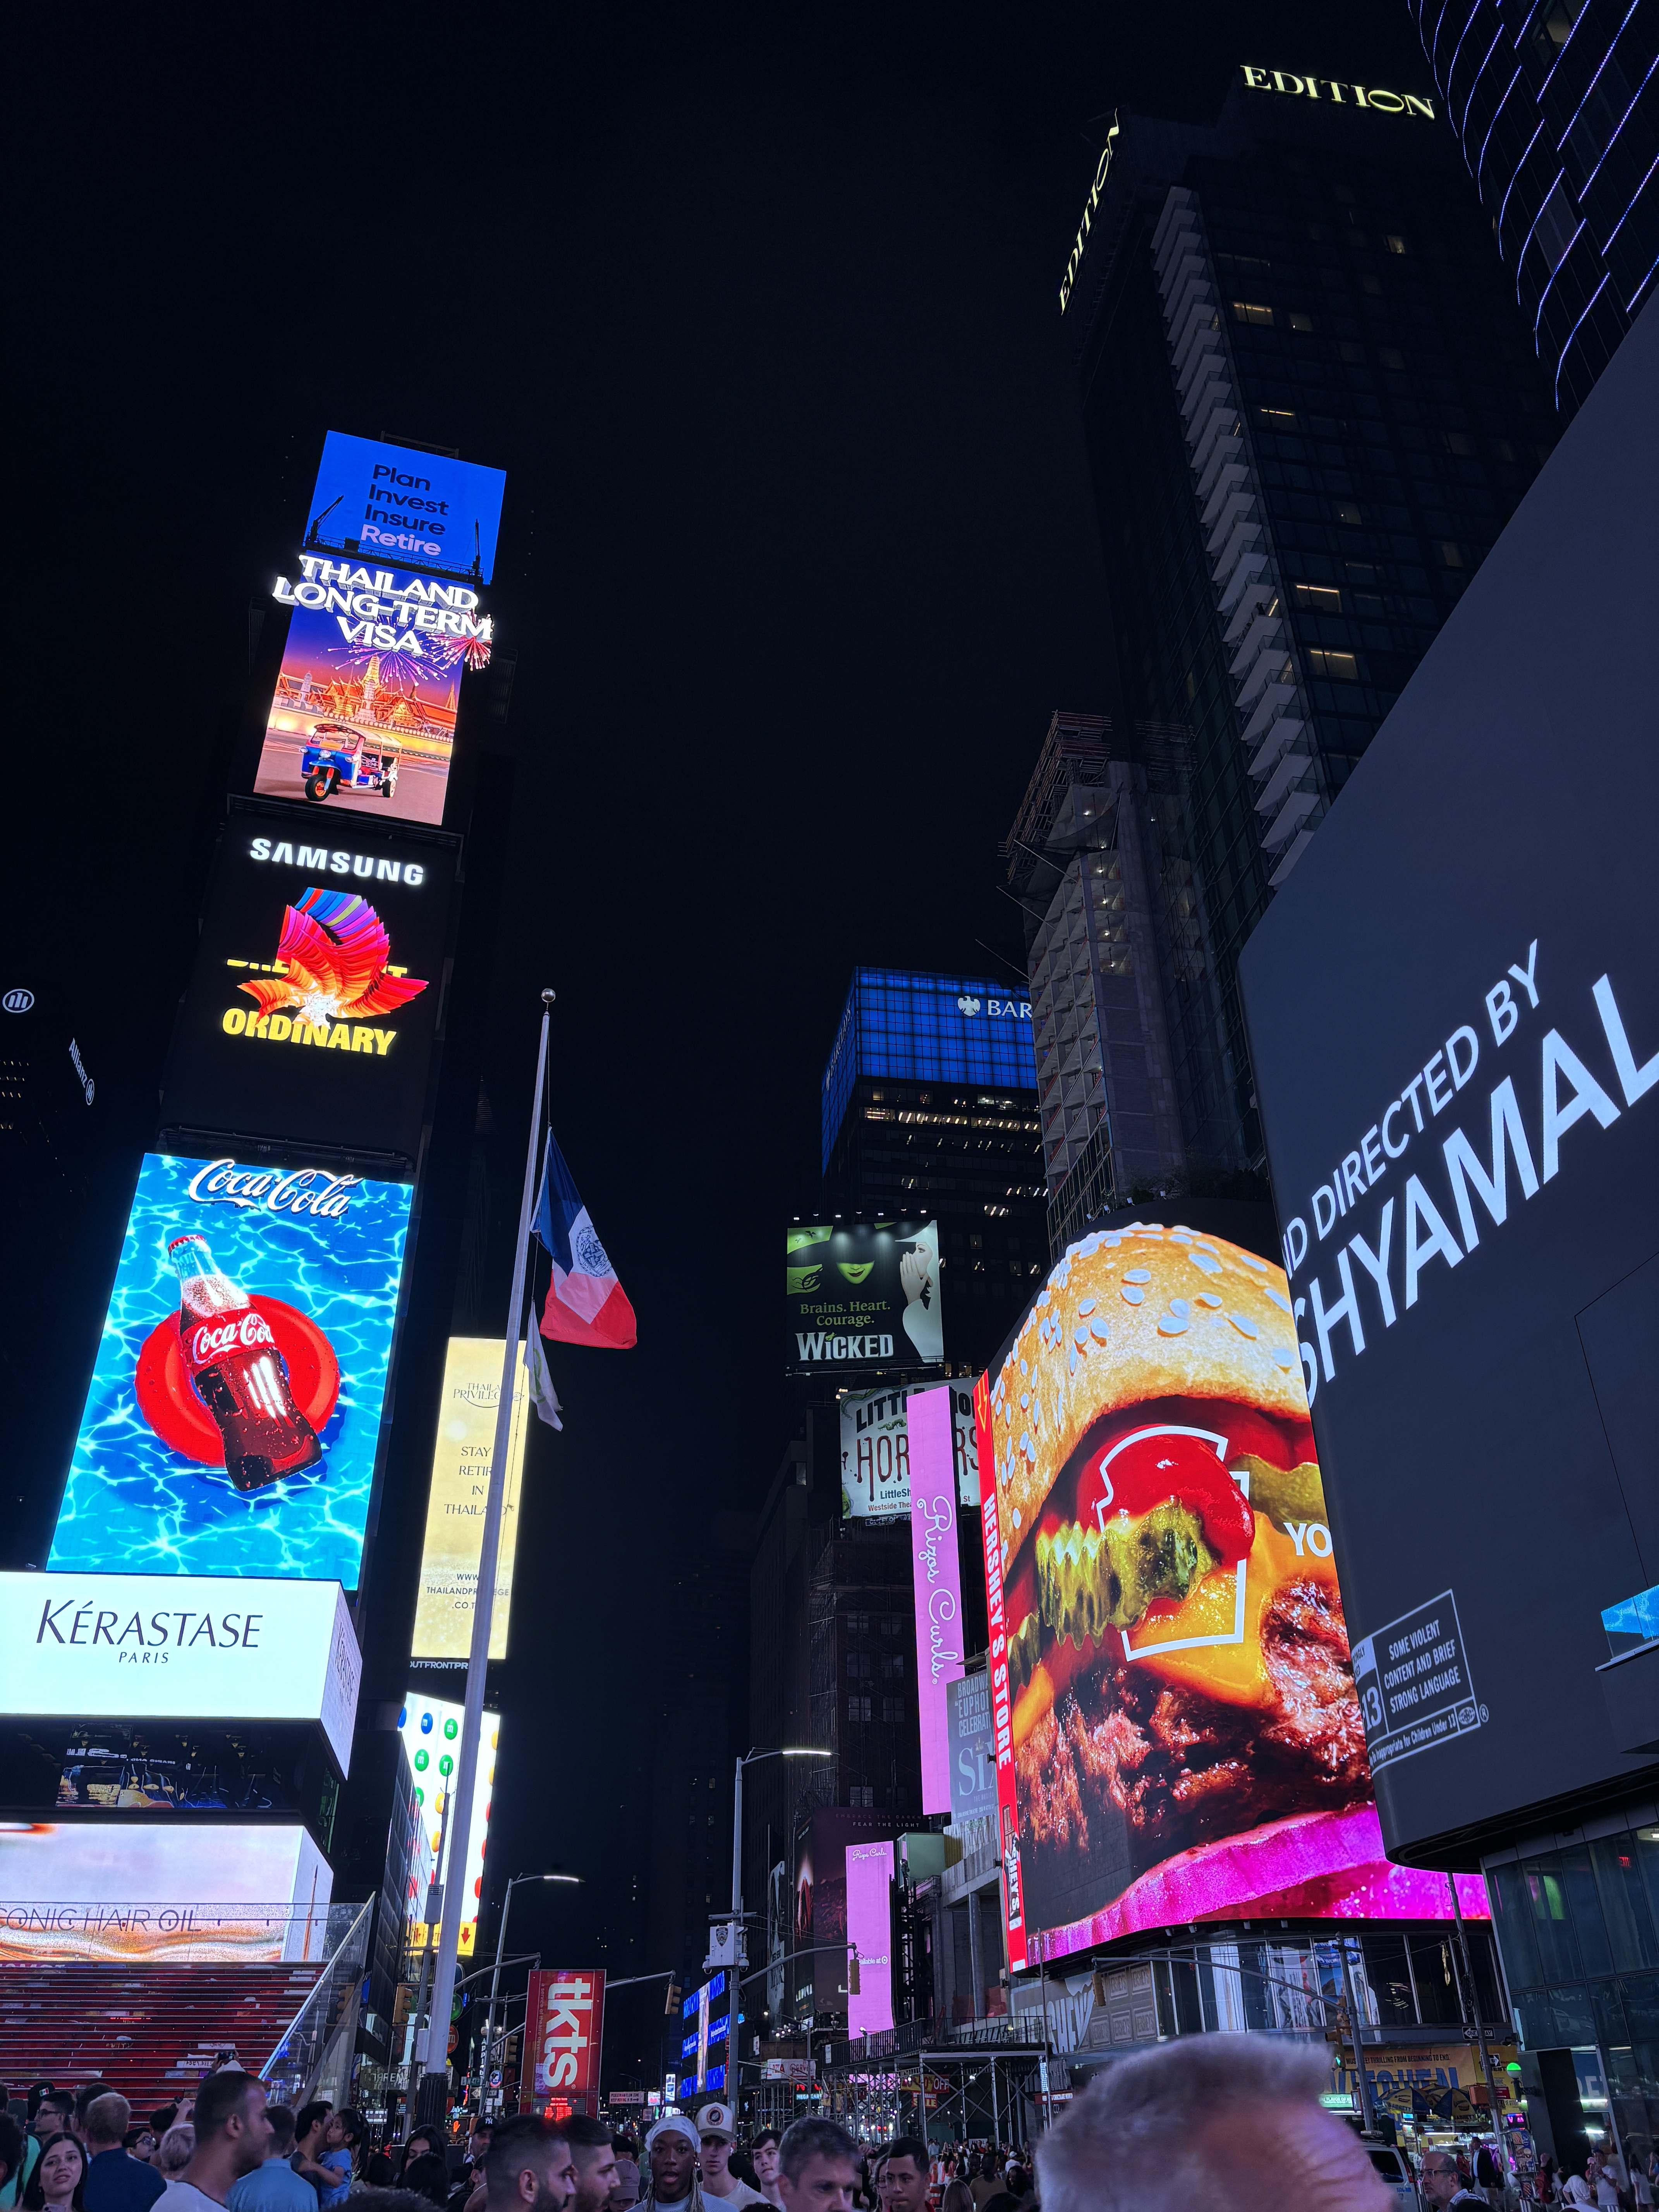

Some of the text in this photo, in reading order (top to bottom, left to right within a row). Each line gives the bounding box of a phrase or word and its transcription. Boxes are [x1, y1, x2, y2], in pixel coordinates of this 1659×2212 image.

[1240, 64, 1435, 120] EDITION
[1059, 108, 1120, 316] EDITION
[373, 464, 430, 491] Plan
[368, 484, 449, 516] Invest
[365, 504, 445, 535] Insure
[361, 524, 441, 556] Retire
[299, 554, 479, 610] THAILAND
[272, 576, 493, 642] LONG-TERM
[336, 615, 423, 656] VISA
[250, 838, 424, 886] SAMSUNG
[988, 1000, 1033, 1019] BAR
[69, 1037, 88, 1089] Allianz
[1312, 1024, 1480, 1241] DIRECTED
[1486, 938, 1540, 1047] BY
[800, 1300, 891, 1314] Brains. Heart.
[816, 1315, 874, 1327] Courage.
[453, 1389, 500, 1400] PRIVILEG
[466, 1383, 500, 1391] THAILA
[461, 1446, 491, 1456] STAY
[459, 1466, 492, 1476] RETIR
[472, 1486, 484, 1495] IN
[880, 1490, 911, 1499] LittleSh
[444, 1504, 507, 1515] THAILAD
[868, 1503, 897, 1511] Westside
[1283, 1522, 1333, 1557] YO
[427, 1587, 509, 1595] THAILANDPREGE
[916, 1495, 959, 1678] Rizos Curls
[36, 1599, 263, 1648] KÉRASTASE
[984, 1492, 1012, 1771] HERSHEY'S STORE
[1389, 1620, 1440, 1661] SOME VIOLENT
[119, 1651, 169, 1664] PARIS
[410, 1661, 469, 1669] UTFRONTPR
[1384, 1660, 1415, 1689] CONTENT
[1417, 1652, 1432, 1674] AND
[1433, 1639, 1456, 1665] BRIEF
[958, 1673, 988, 1698] BROADWA
[1390, 1666, 1460, 1714] STRONG LANGUAGE
[959, 1712, 990, 1738] CELEBRAT
[1411, 1726, 1432, 1744] Children
[1432, 1719, 1448, 1735] Under
[1448, 1714, 1456, 1728] 13
[84, 1908, 150, 1932] HAIR
[159, 1909, 201, 1932] OIL
[543, 1978, 592, 2087] tkts
[934, 2078, 949, 2090] OFF
[913, 2098, 936, 2107] SLE
